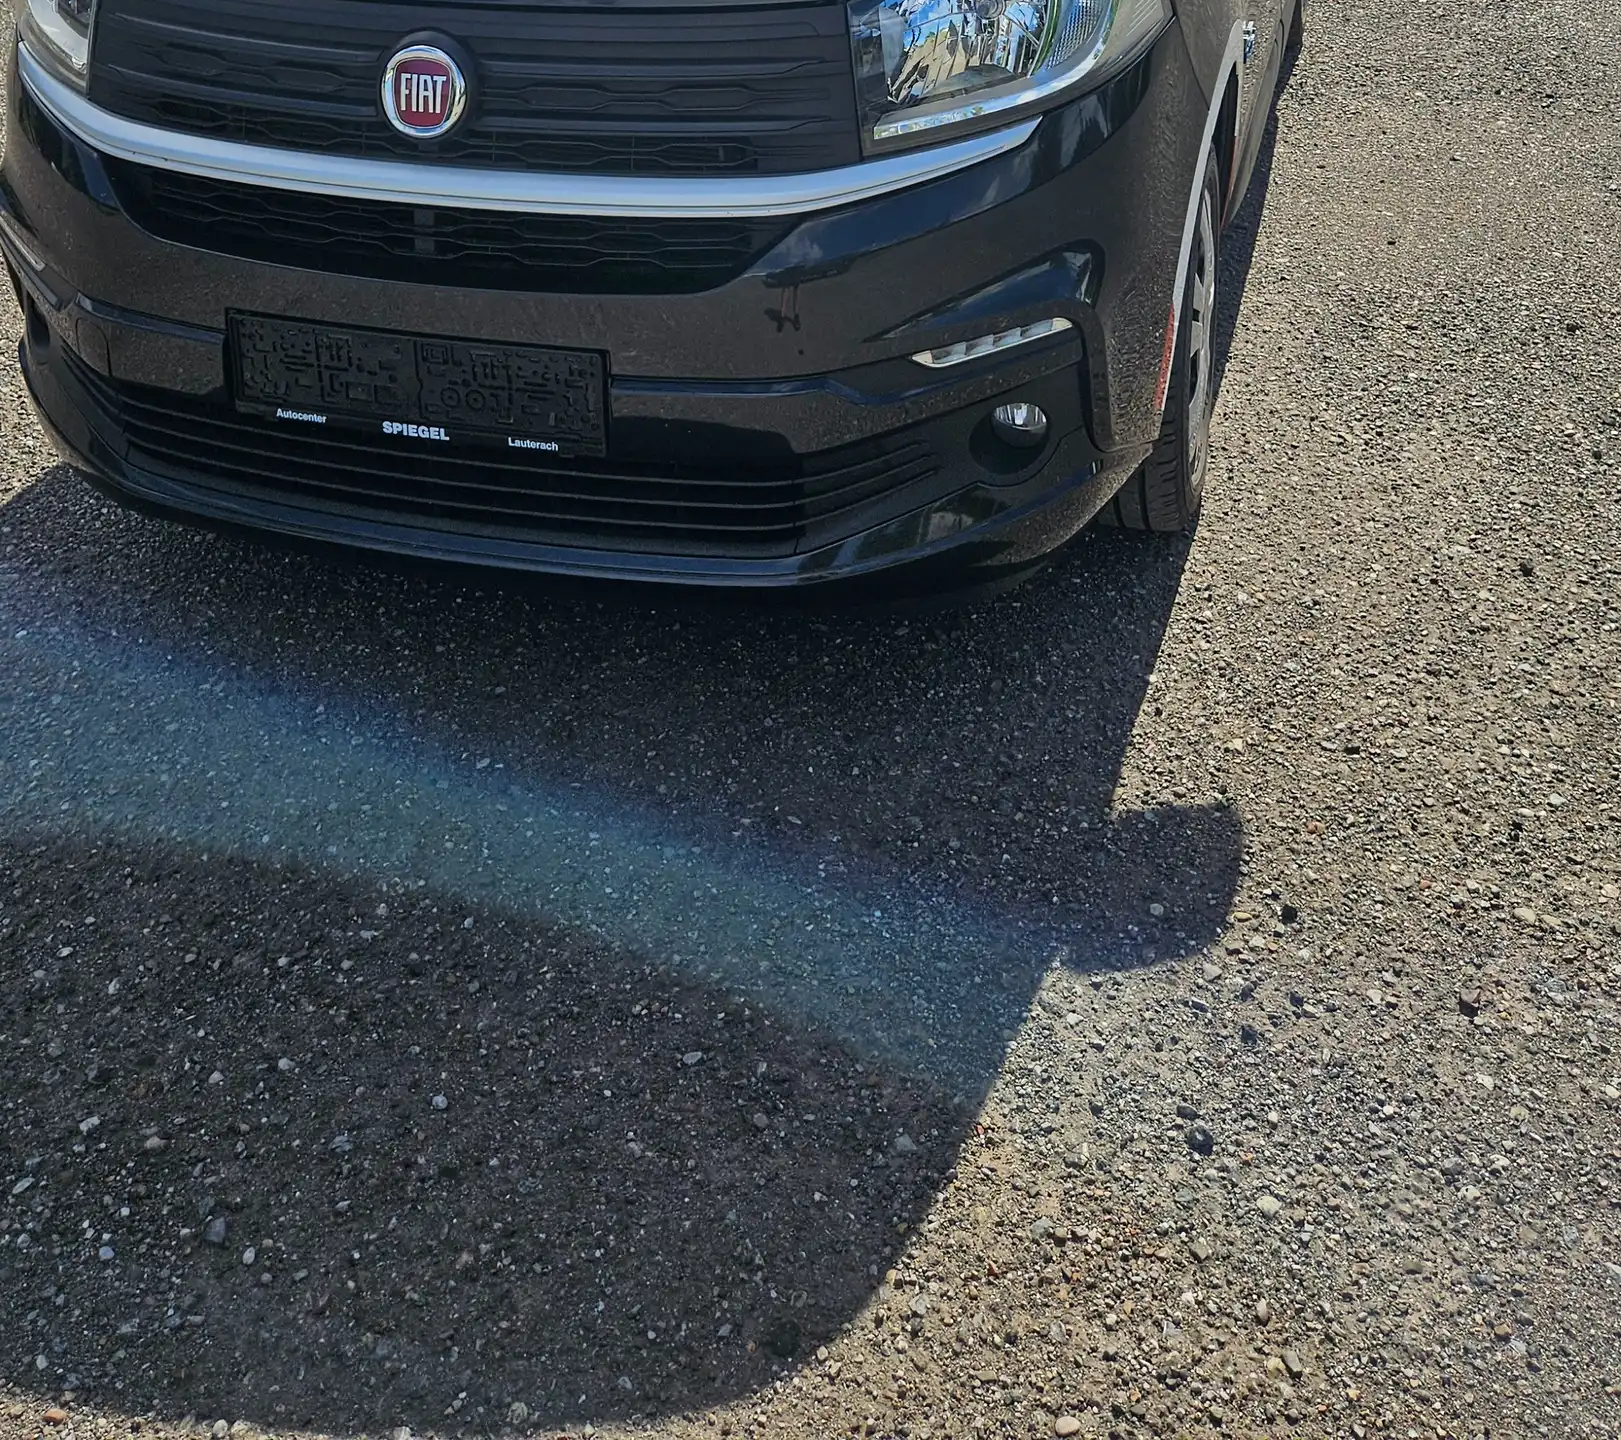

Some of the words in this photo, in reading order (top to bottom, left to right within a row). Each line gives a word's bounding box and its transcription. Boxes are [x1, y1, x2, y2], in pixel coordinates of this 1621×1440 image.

[400, 73, 447, 114] FIAT
[276, 408, 327, 423] Autocenter
[382, 420, 450, 441] SPIEGEL
[508, 436, 559, 452] Lauterach
